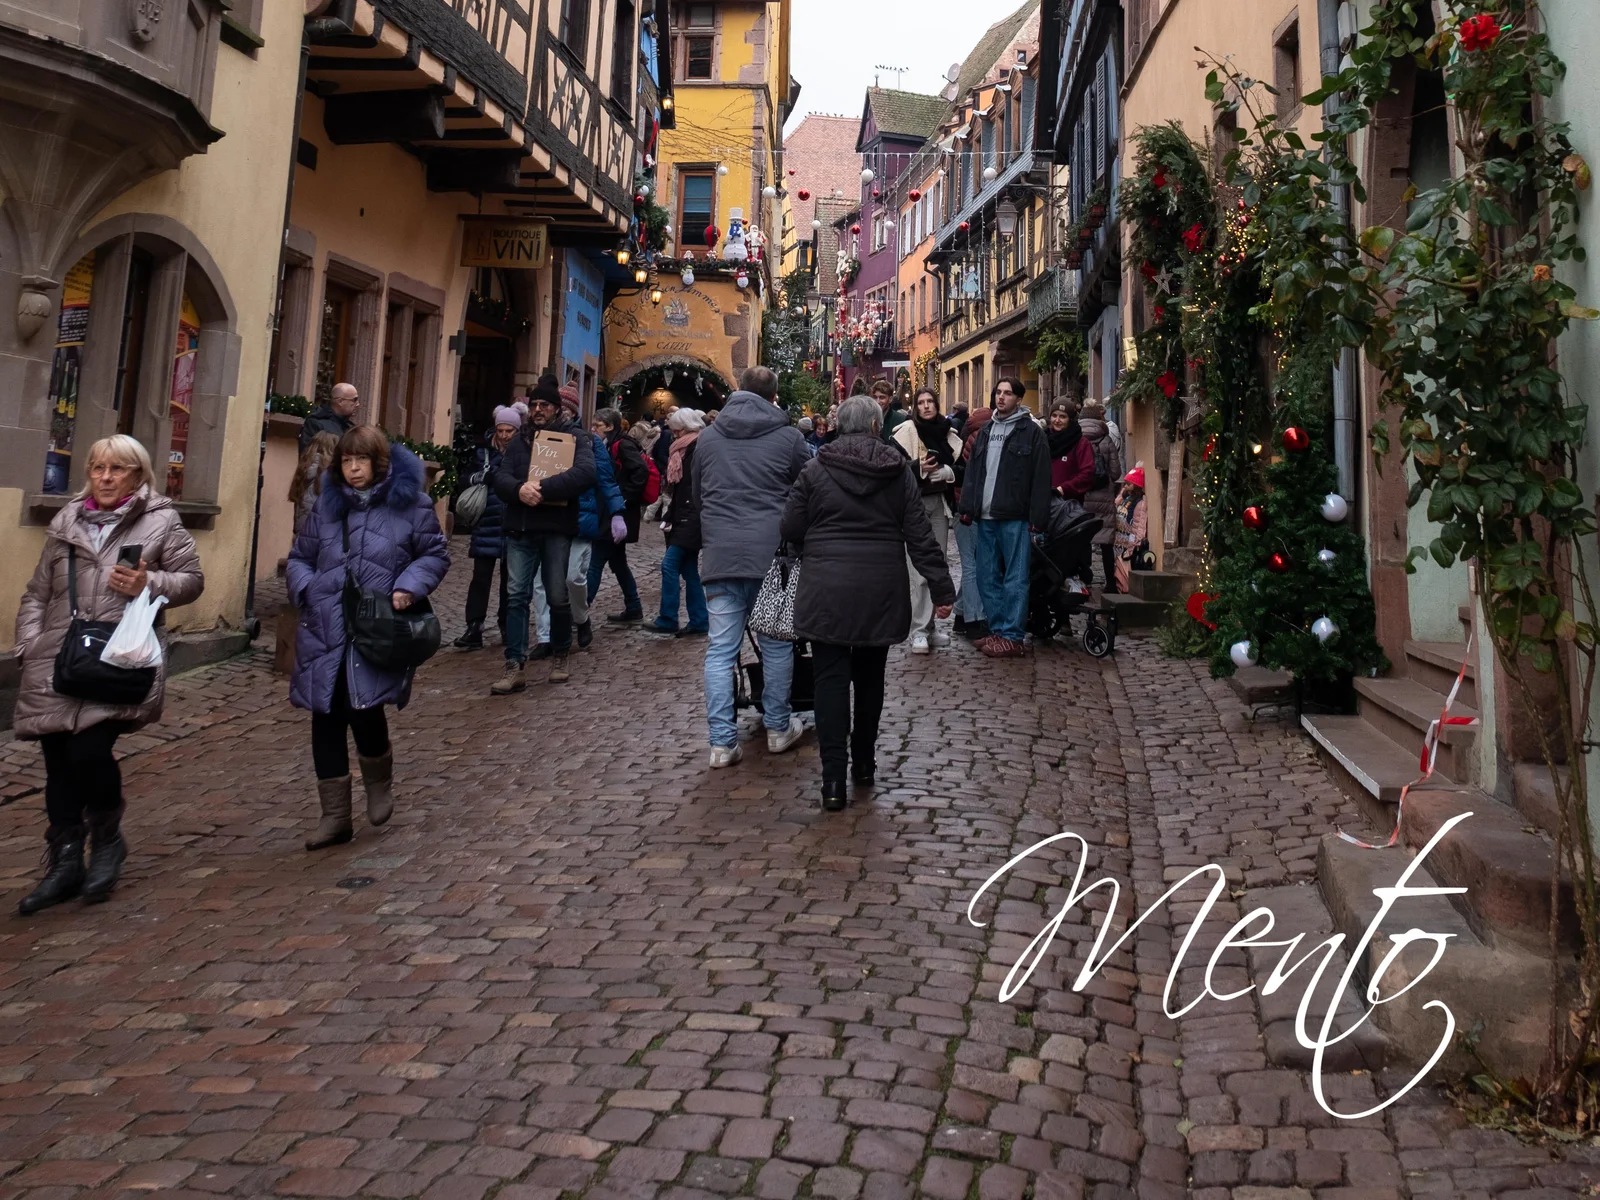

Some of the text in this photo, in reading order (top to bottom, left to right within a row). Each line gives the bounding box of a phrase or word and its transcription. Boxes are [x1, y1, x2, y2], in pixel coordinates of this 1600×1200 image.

[493, 229, 541, 239] BOUTIQUE
[493, 239, 541, 261] VINI
[535, 442, 559, 458] Vin
